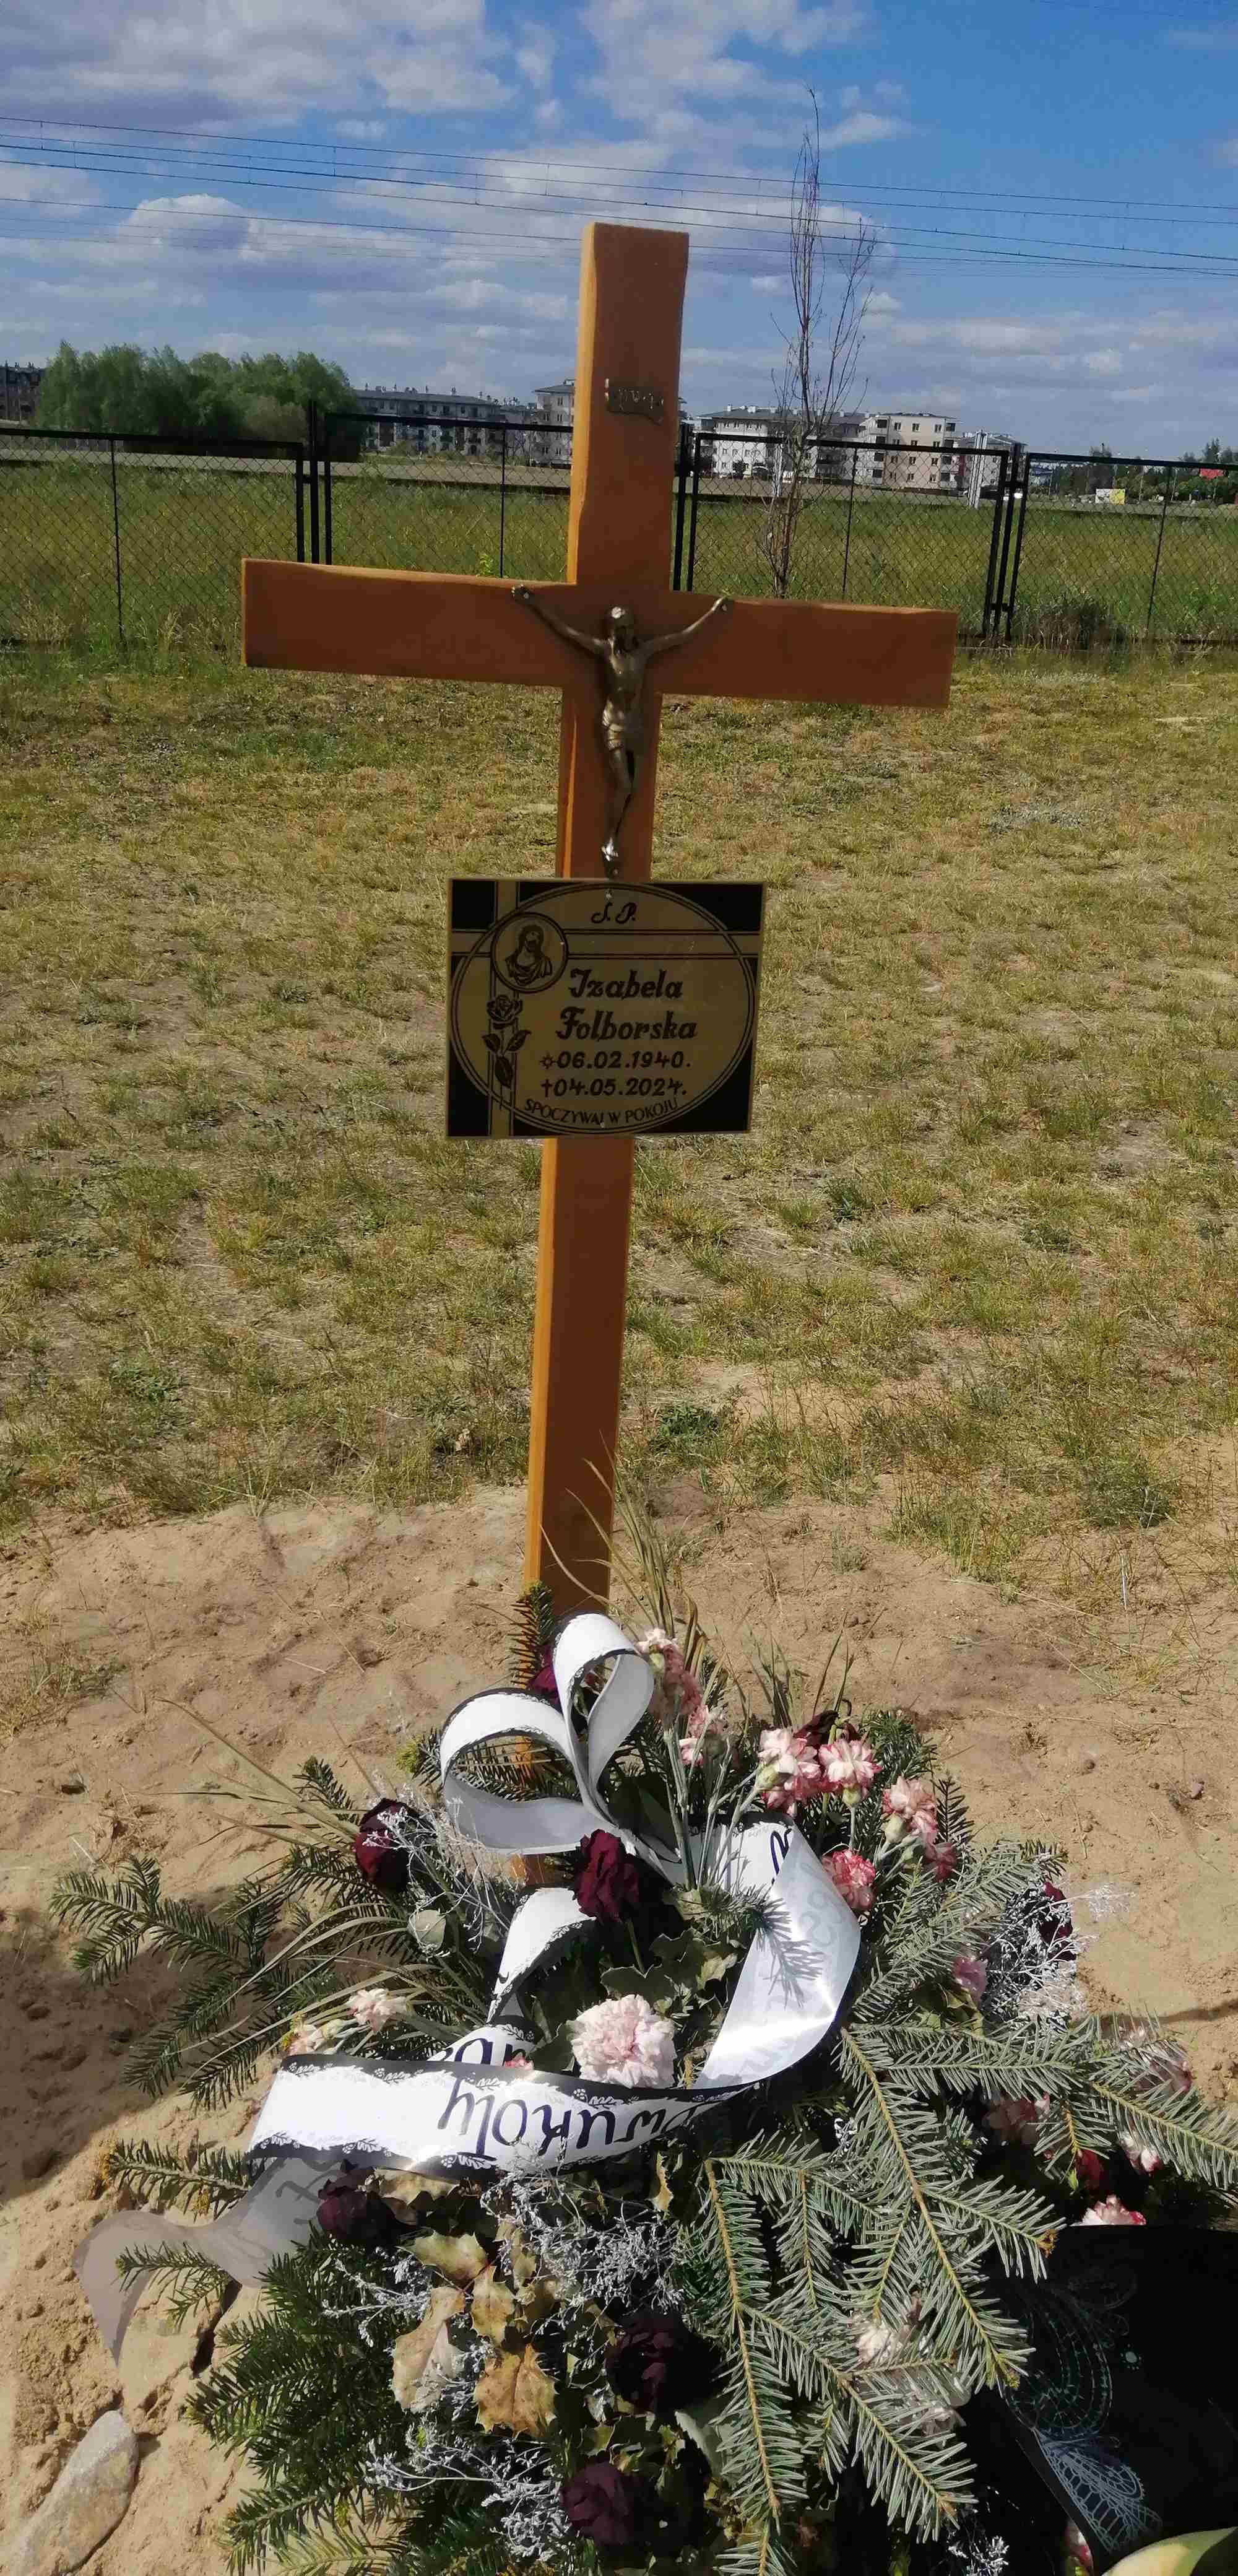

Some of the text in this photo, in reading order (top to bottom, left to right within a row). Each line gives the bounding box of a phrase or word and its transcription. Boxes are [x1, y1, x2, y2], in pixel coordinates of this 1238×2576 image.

[568, 968, 683, 999] Izabela
[555, 1006, 698, 1042] Folborska
[524, 1098, 679, 1125] SPOCZYWAJ W POKOJU
